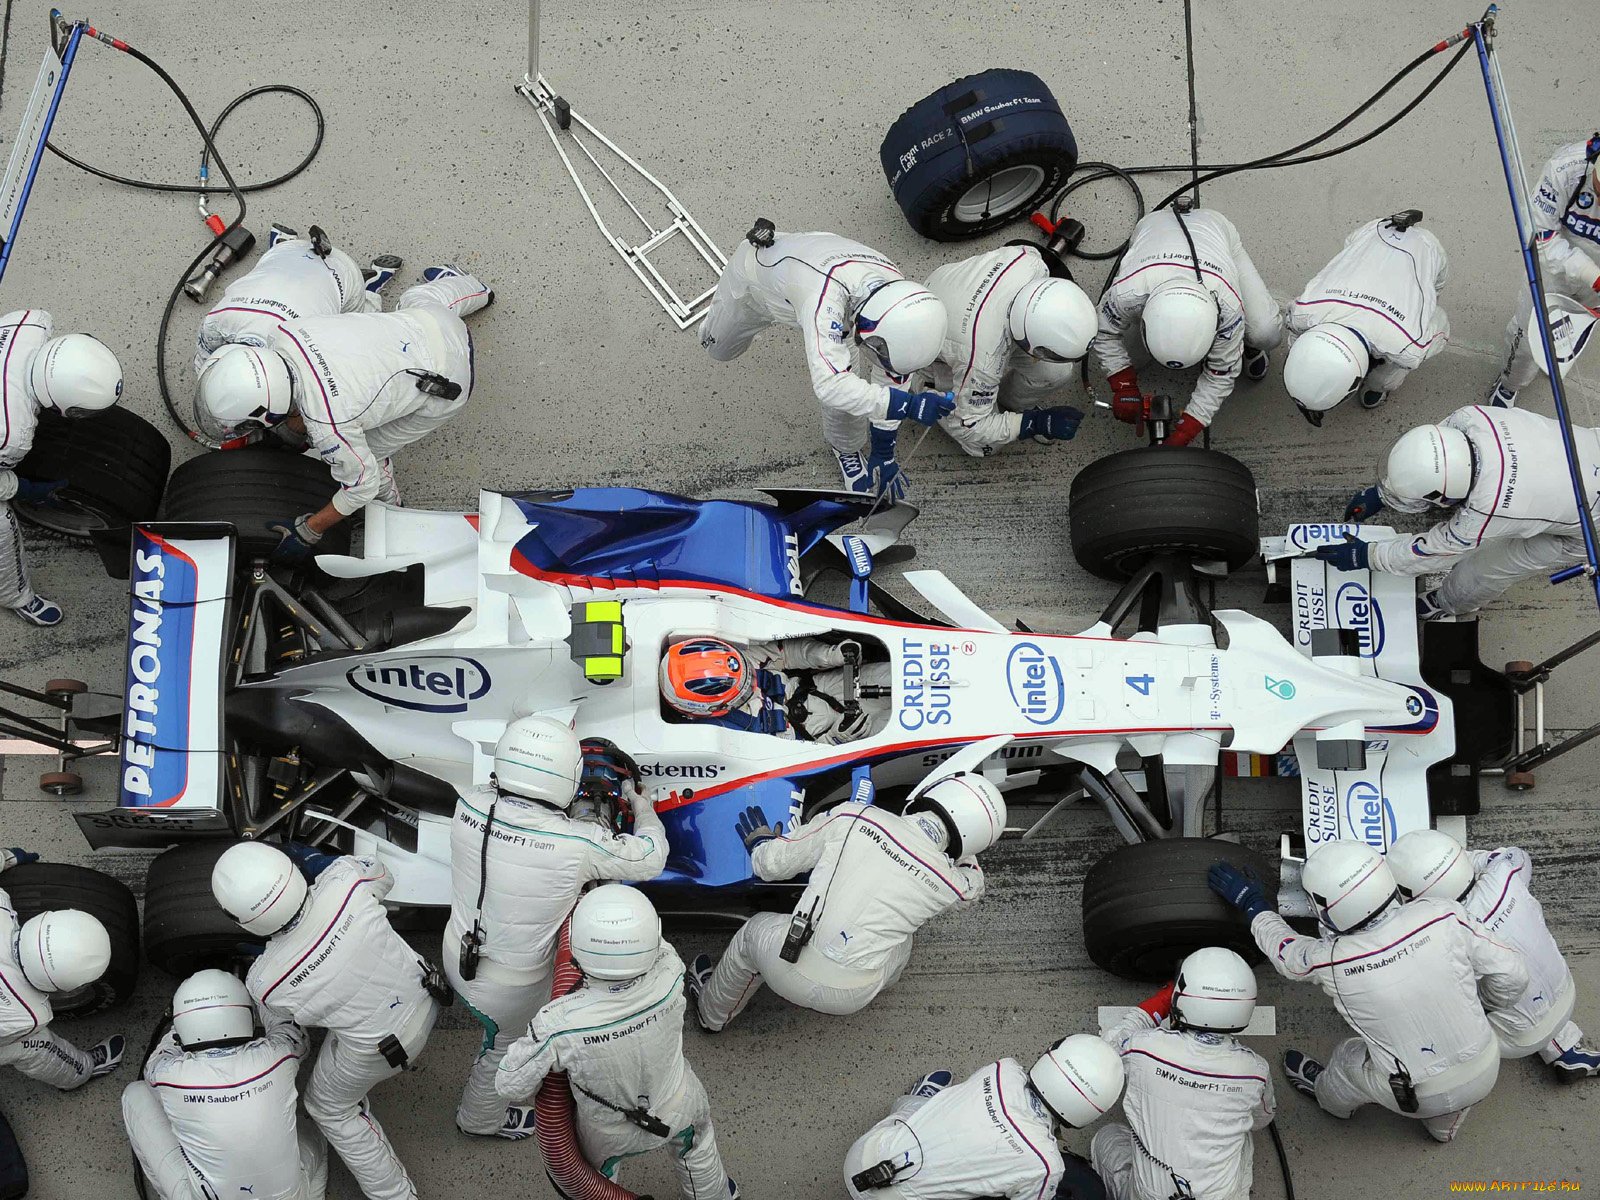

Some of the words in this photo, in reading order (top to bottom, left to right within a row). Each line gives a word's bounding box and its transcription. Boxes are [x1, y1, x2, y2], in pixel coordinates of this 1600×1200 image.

[961, 110, 983, 124] BMW
[984, 101, 1013, 113] Sauber
[921, 131, 945, 150] RACE
[946, 127, 953, 136] 2
[899, 144, 919, 164] Front
[901, 156, 917, 173] Left
[3, 187, 17, 219] BMW
[987, 262, 1004, 279] BMW
[250, 297, 264, 305] F1
[974, 278, 990, 302] Sauber
[1360, 294, 1387, 308] Sauber
[265, 298, 288, 311] Sauber
[965, 301, 976, 312] F1
[1387, 305, 1406, 322] BMW
[308, 343, 319, 355] F1
[316, 352, 332, 378] Sauber
[327, 377, 339, 397] BMW
[1507, 442, 1515, 453] F1
[1509, 452, 1518, 485] Sauber
[1502, 486, 1515, 509] BMW
[785, 532, 804, 597] DELL
[1296, 580, 1312, 646] CREDIT
[1312, 587, 1325, 629] UISSE
[123, 548, 165, 797] PETRONAS
[363, 664, 466, 700] intel
[899, 637, 925, 731] CREDIT
[926, 643, 951, 725] SUISSE
[1019, 655, 1047, 714] intel
[1125, 673, 1155, 696] 4
[787, 788, 805, 832] ELL
[1307, 777, 1321, 844] CREDIT
[1322, 785, 1338, 842] SUISSE
[1357, 794, 1383, 847] intel
[459, 811, 479, 829] BMW
[479, 822, 514, 842] Suber
[513, 835, 526, 847] F1
[528, 838, 555, 851] Team
[859, 825, 883, 844] BMW
[880, 841, 910, 869] Sauber
[907, 863, 920, 877] F1
[920, 872, 940, 893] Team
[1493, 917, 1505, 929] F1
[290, 968, 311, 988] BMW
[308, 946, 333, 971] Sauber
[330, 935, 342, 948] F1
[339, 914, 355, 936] Team
[1343, 964, 1367, 977] BMW
[1366, 954, 1398, 971] Sauber
[1397, 948, 1409, 960] F1
[1409, 935, 1432, 953] Team
[583, 1033, 610, 1045] BMW
[611, 1021, 646, 1040] Sauber
[645, 1015, 658, 1027] F1
[658, 998, 680, 1018] Team
[183, 1094, 206, 1104] BMW
[207, 1094, 240, 1104] Sauber
[240, 1090, 251, 1101] F1
[252, 1079, 274, 1096] Team
[982, 1075, 994, 1094] BMW
[1155, 1067, 1178, 1083] BMW
[1178, 1076, 1209, 1091] Sauber
[1208, 1083, 1219, 1091] F1
[1221, 1084, 1243, 1093] Team
[984, 1093, 1001, 1127] Sauber
[998, 1122, 1008, 1135] F1
[1004, 1129, 1024, 1154] Team
